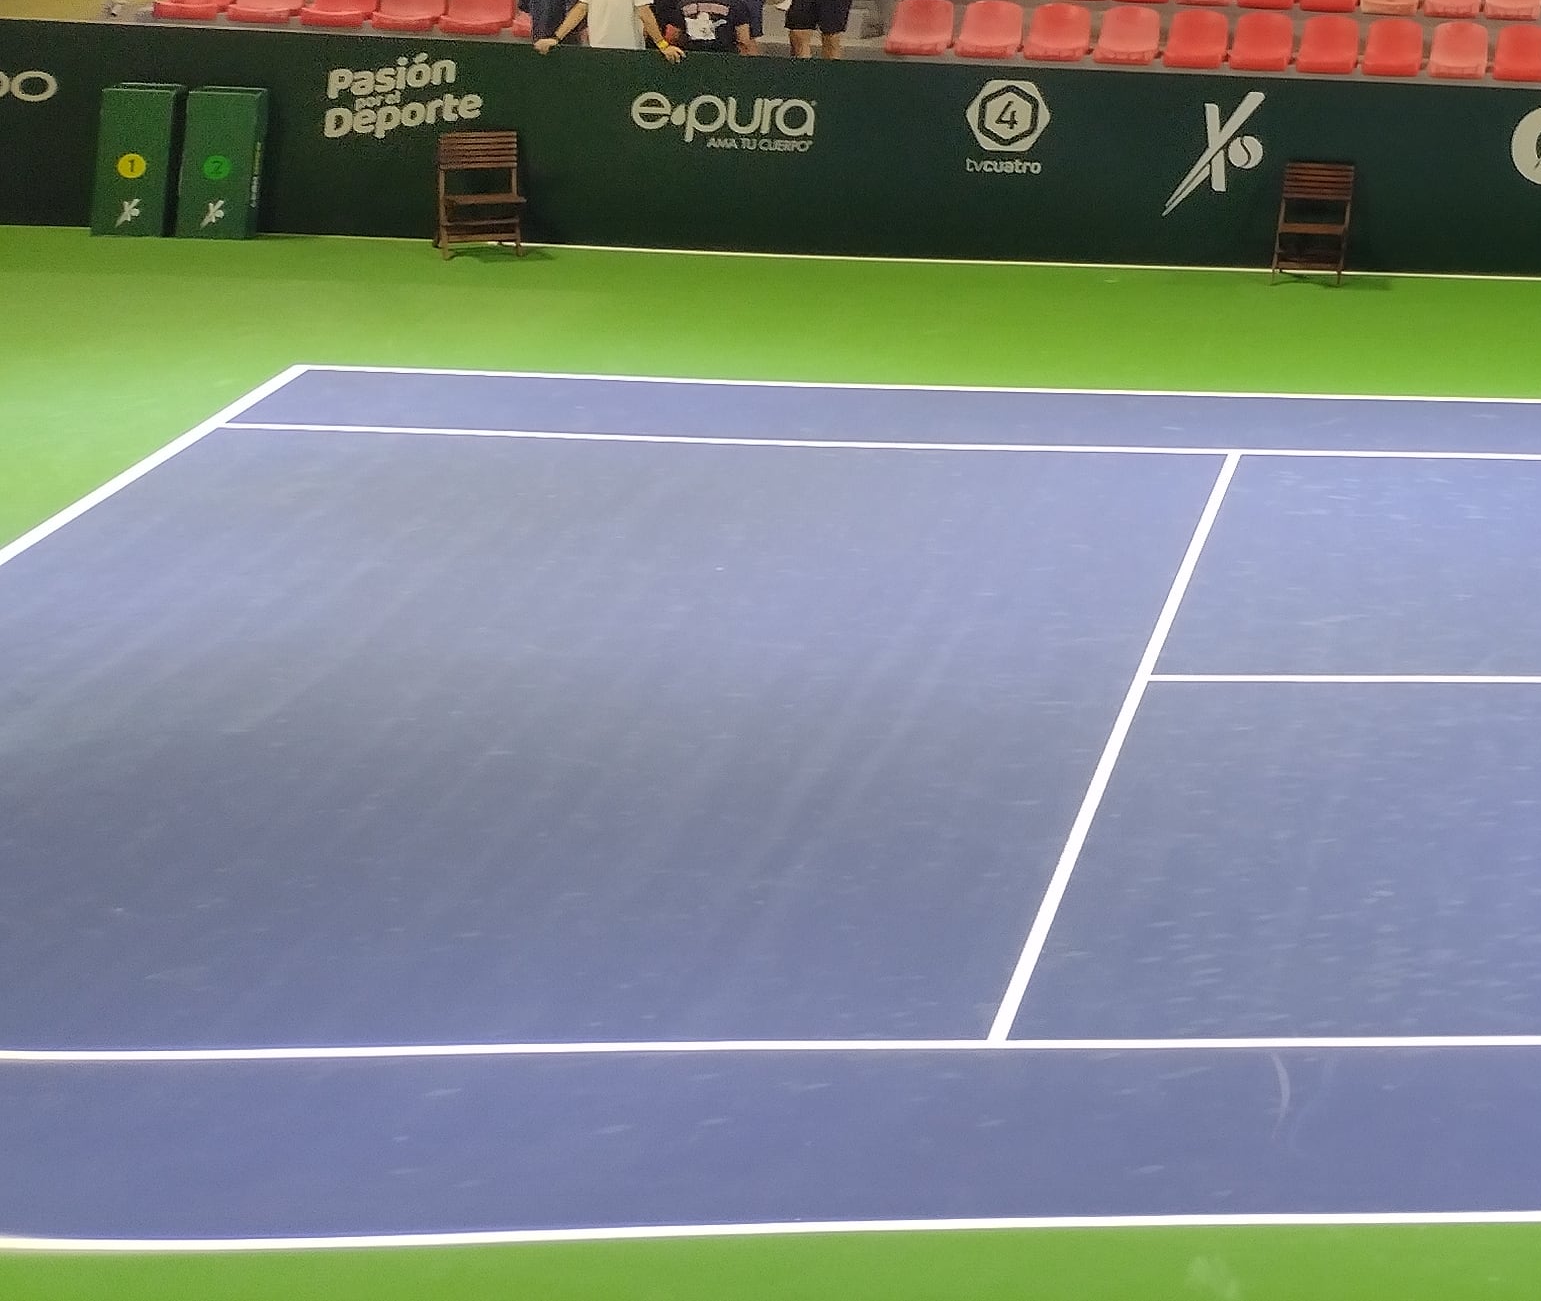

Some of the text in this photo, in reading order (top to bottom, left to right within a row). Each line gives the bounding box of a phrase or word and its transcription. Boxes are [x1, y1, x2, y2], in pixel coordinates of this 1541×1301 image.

[327, 52, 457, 99] Pasión
[324, 93, 484, 139] Deporte
[994, 100, 1019, 130] 4
